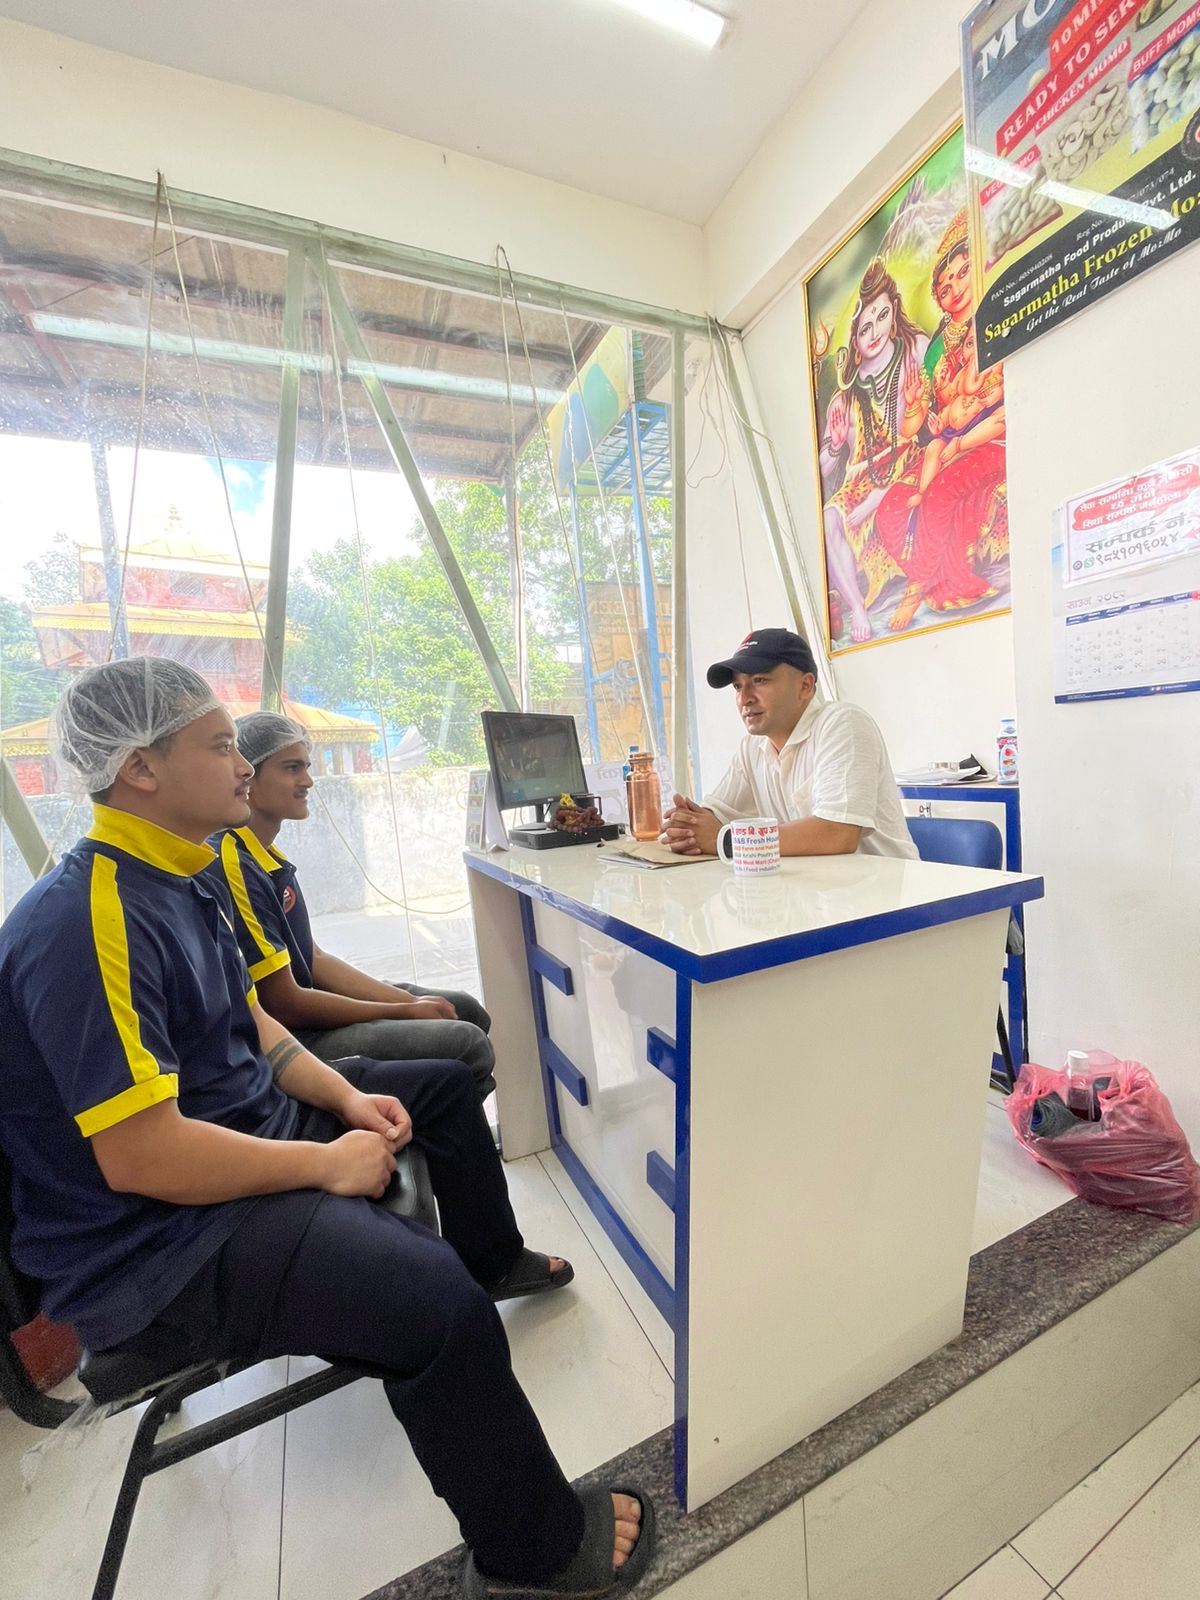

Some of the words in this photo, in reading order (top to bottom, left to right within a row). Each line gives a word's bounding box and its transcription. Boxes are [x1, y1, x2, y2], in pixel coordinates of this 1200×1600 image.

[1003, 74, 1058, 144] READY
[1064, 43, 1091, 75] TO
[1035, 79, 1085, 130] CHICKEN
[1087, 40, 1128, 82] MOMO
[1133, 38, 1163, 73] BUFF
[984, 272, 1080, 342] Sagarmatha
[1083, 224, 1153, 279] Frozen
[1003, 263, 1061, 307] Sagarmatha
[1063, 240, 1090, 266] Food
[1169, 169, 1196, 194] Ltd.
[1026, 314, 1043, 332] Get
[1045, 305, 1060, 320] the
[1062, 284, 1087, 307] Real
[1090, 267, 1119, 289] Taste
[1122, 253, 1136, 271] of
[1085, 520, 1158, 553] सम्पर्क
